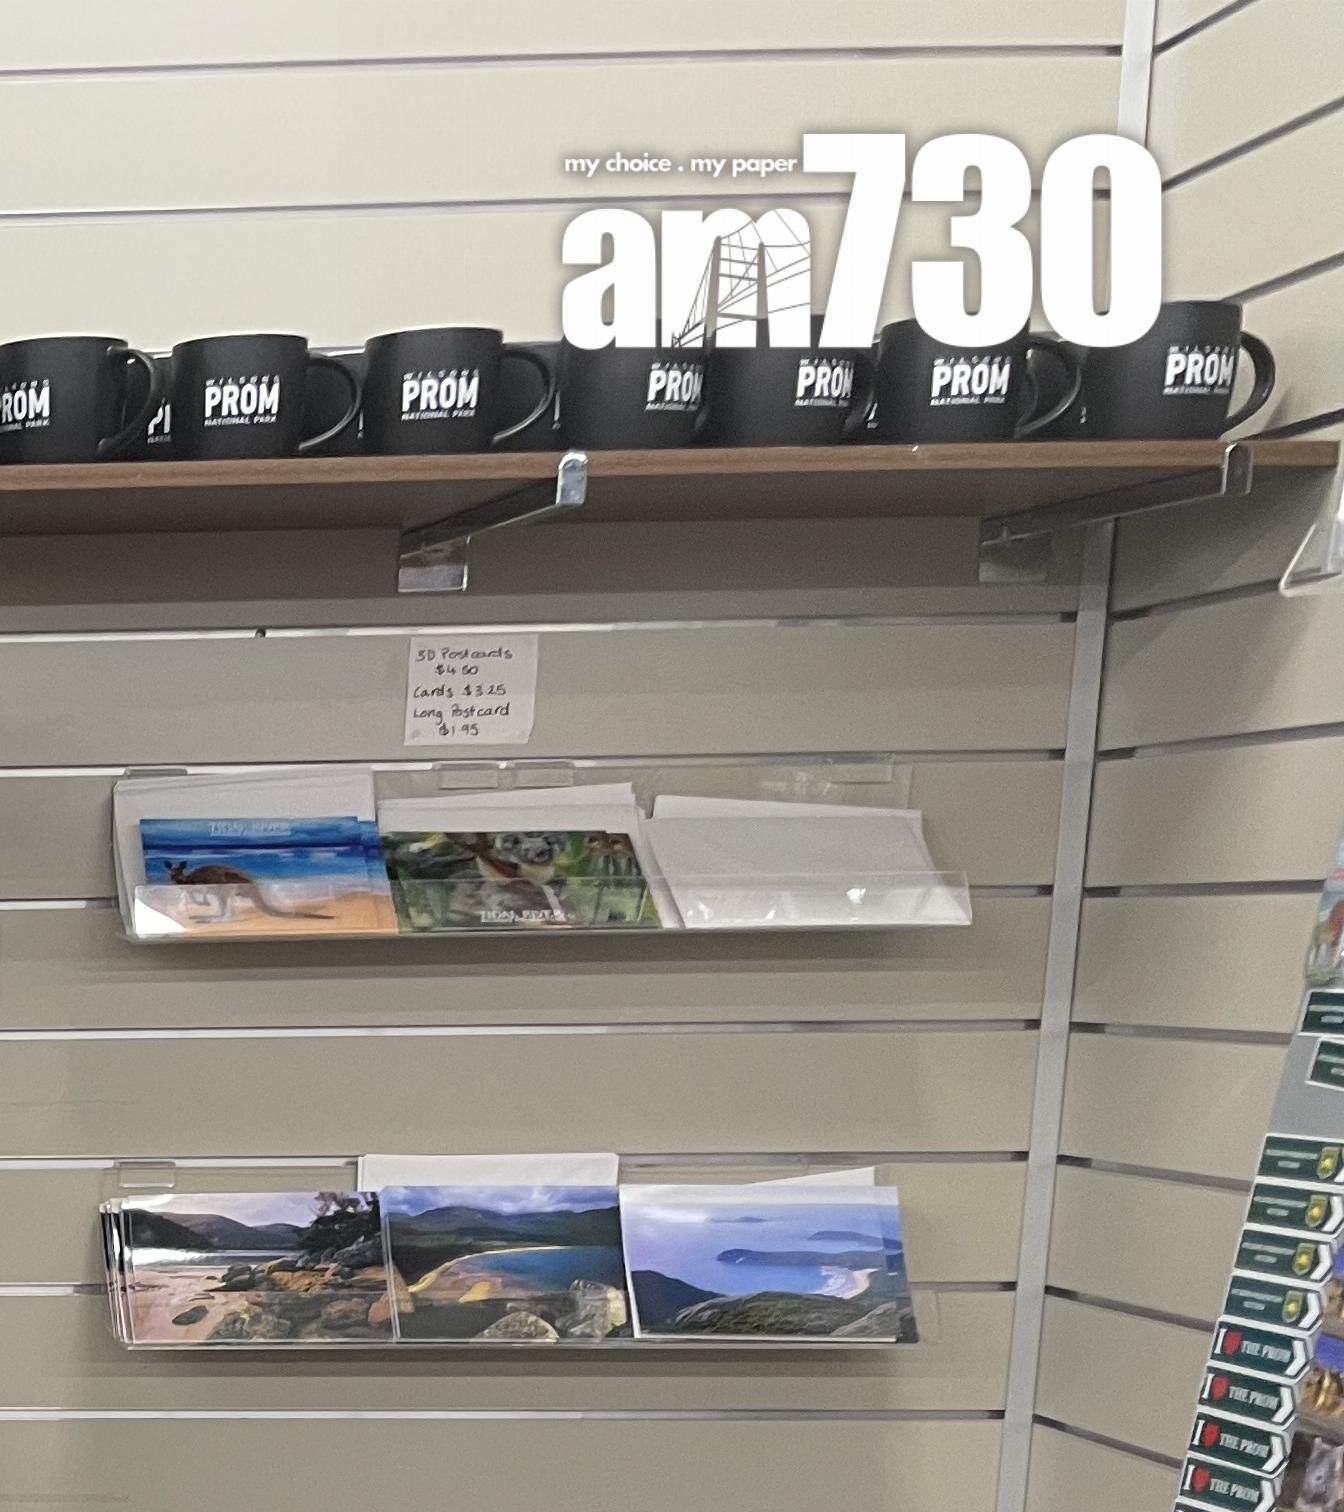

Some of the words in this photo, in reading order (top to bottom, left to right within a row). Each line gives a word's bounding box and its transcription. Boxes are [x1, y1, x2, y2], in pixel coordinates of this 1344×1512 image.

[647, 369, 704, 402] PROM
[795, 365, 855, 398] PROM
[930, 364, 1011, 398] PROM
[1163, 353, 1234, 388] PROM
[204, 383, 281, 418] PROM
[401, 377, 480, 413] PROM
[440, 647, 513, 660] Postcards
[413, 684, 454, 698] Cards
[413, 708, 443, 725] Long
[451, 702, 510, 718] Postcard
[1214, 1328, 1227, 1354] I
[1192, 1419, 1204, 1445] I
